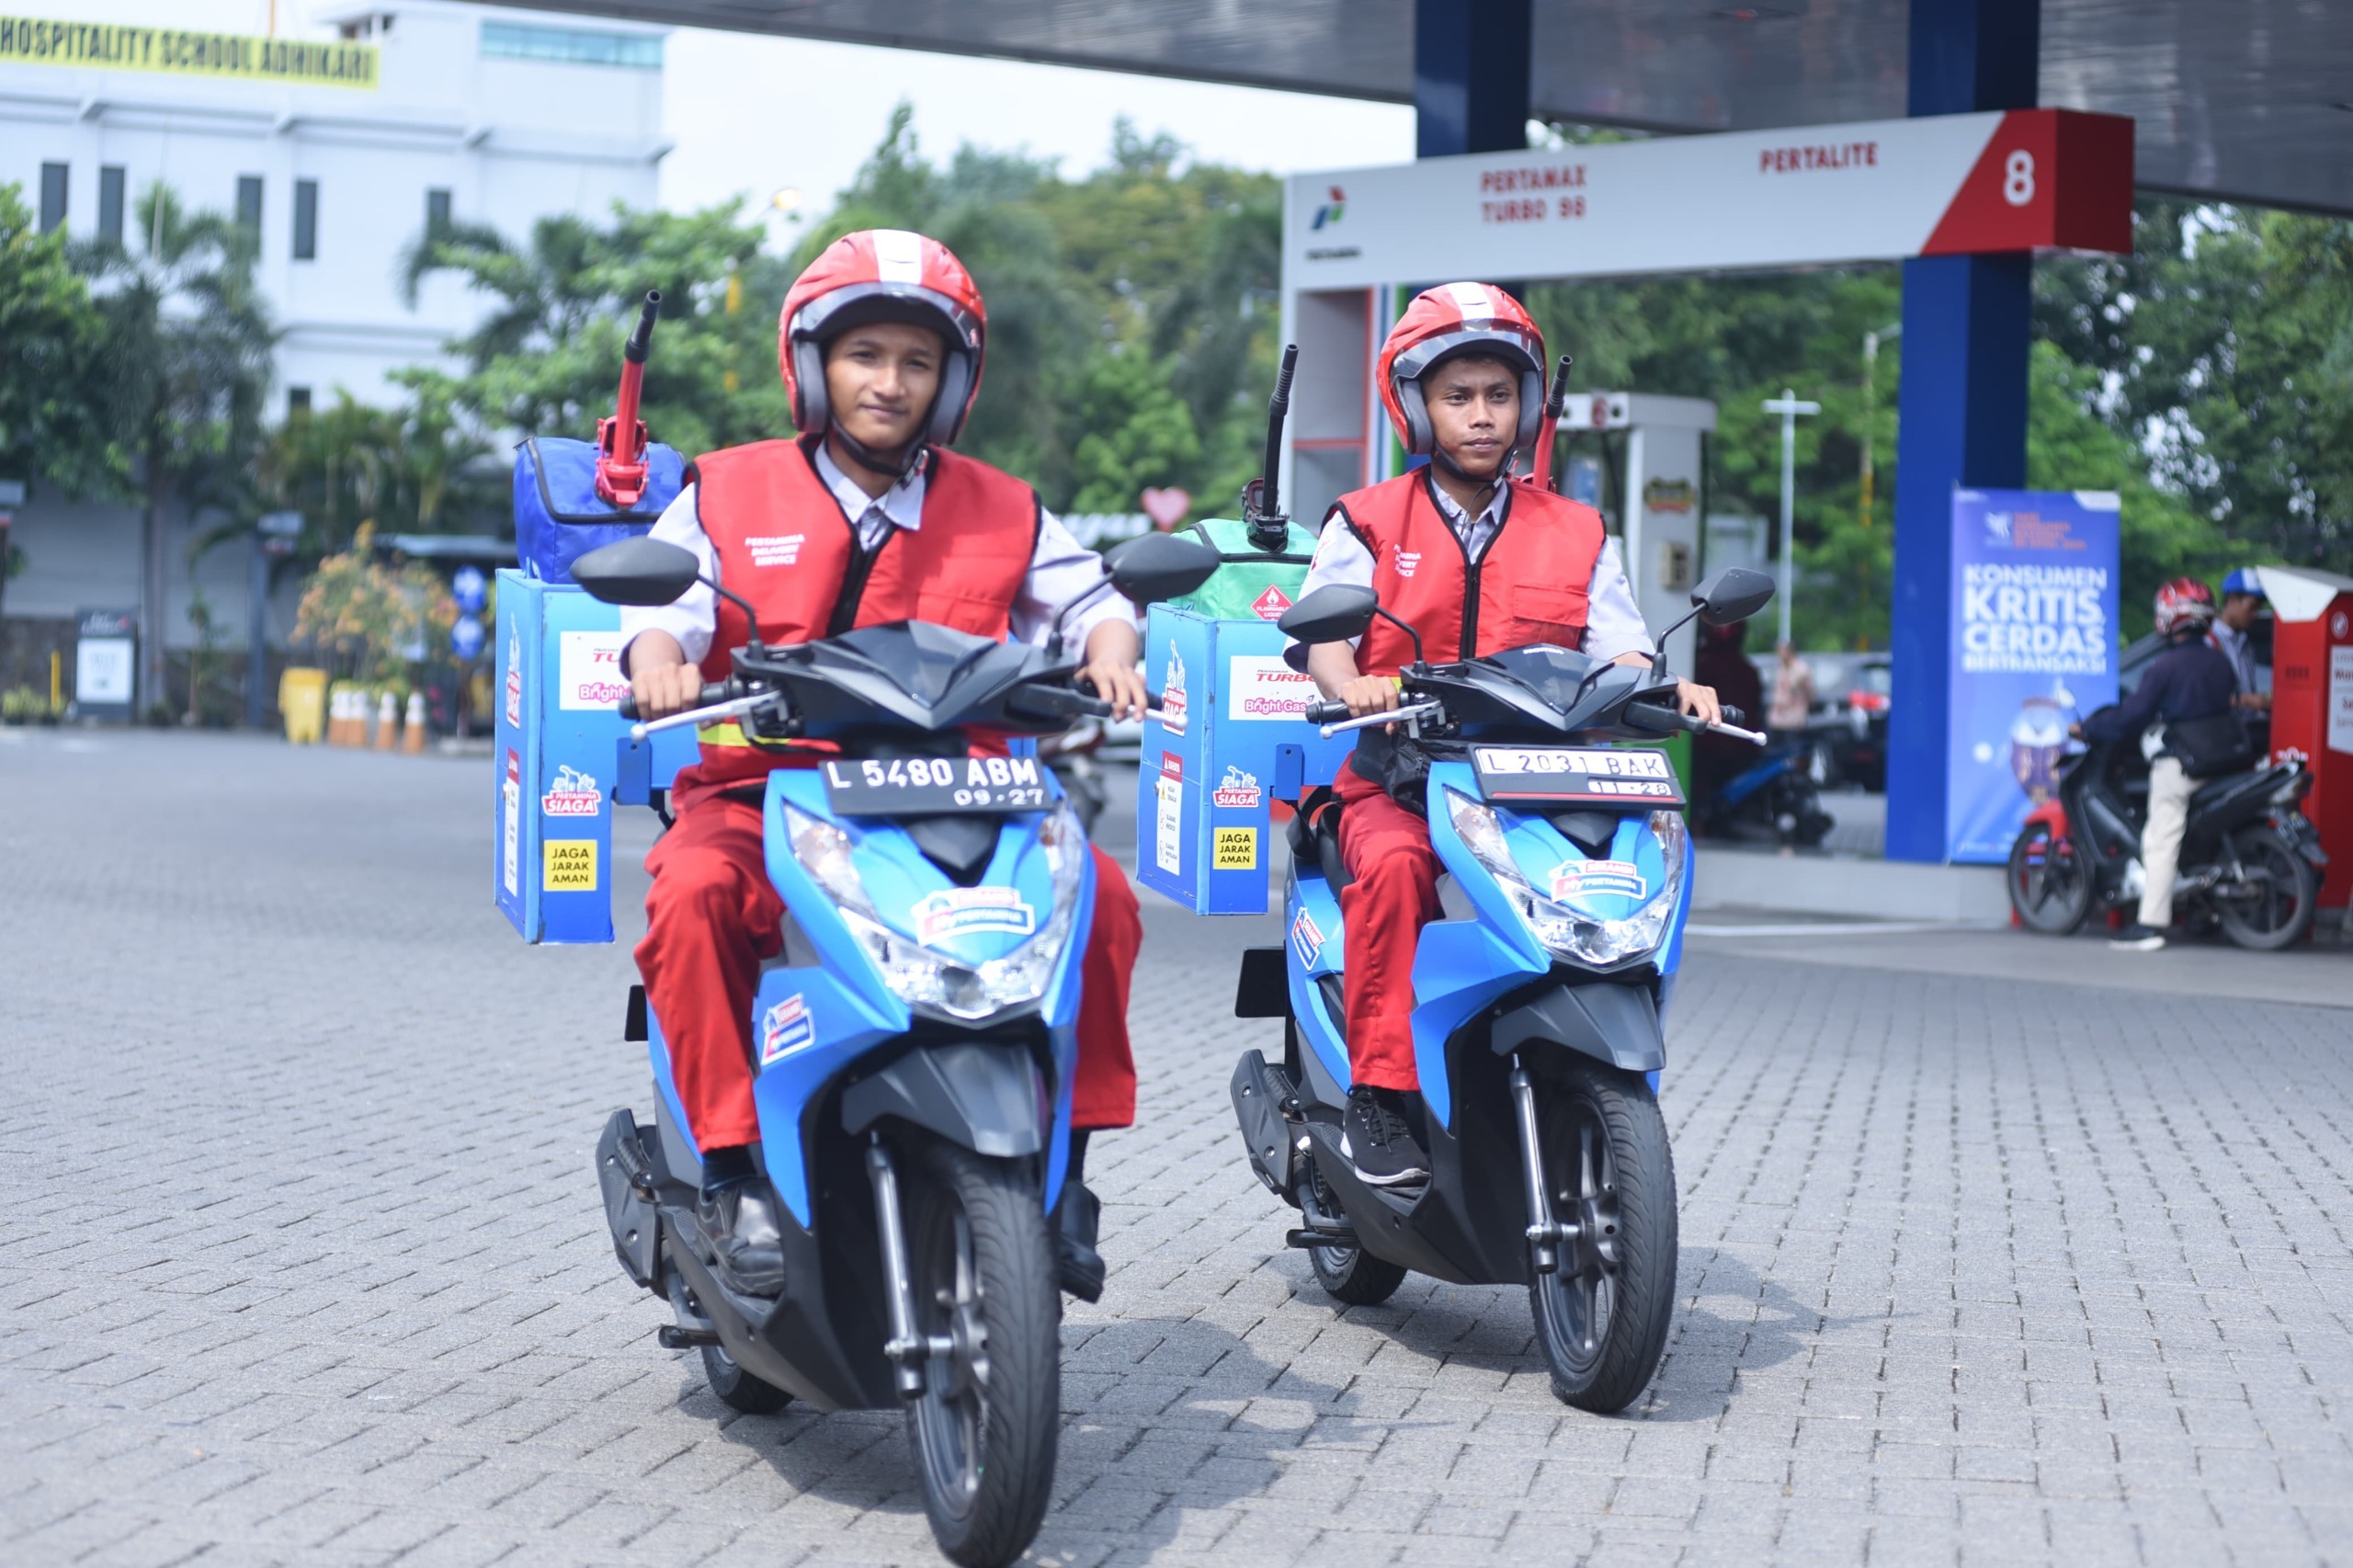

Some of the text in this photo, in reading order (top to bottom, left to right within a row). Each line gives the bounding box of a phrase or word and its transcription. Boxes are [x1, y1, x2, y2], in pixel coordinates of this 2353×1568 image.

[1, 16, 370, 80] HOSPITALITY SCHOOL ADHIKARI
[1759, 142, 1878, 173] PERTALITE
[1481, 165, 1587, 193] PERTAMAX
[2003, 149, 2035, 206] 8
[1482, 199, 1547, 222] TURBO
[745, 533, 805, 547] PERTAMINA
[751, 543, 799, 557] DELIVERY
[755, 554, 796, 567] SERVICE
[1963, 564, 2107, 590] KONSUMEN
[1964, 623, 2107, 655] CERDAS
[1963, 654, 2107, 674] BERTRANSAKSI
[579, 682, 624, 703] Bright
[1245, 698, 1306, 715] Bright Gas
[827, 757, 1039, 788] L 5480 ABM
[1487, 754, 1663, 775] L 2031 BAK
[548, 799, 596, 812] SIAGA
[1218, 794, 1256, 805] SIAGA
[1221, 834, 1251, 843] JAGA
[551, 848, 590, 858] JAGA
[551, 862, 589, 871] JARAK
[551, 874, 589, 883] AMAN
